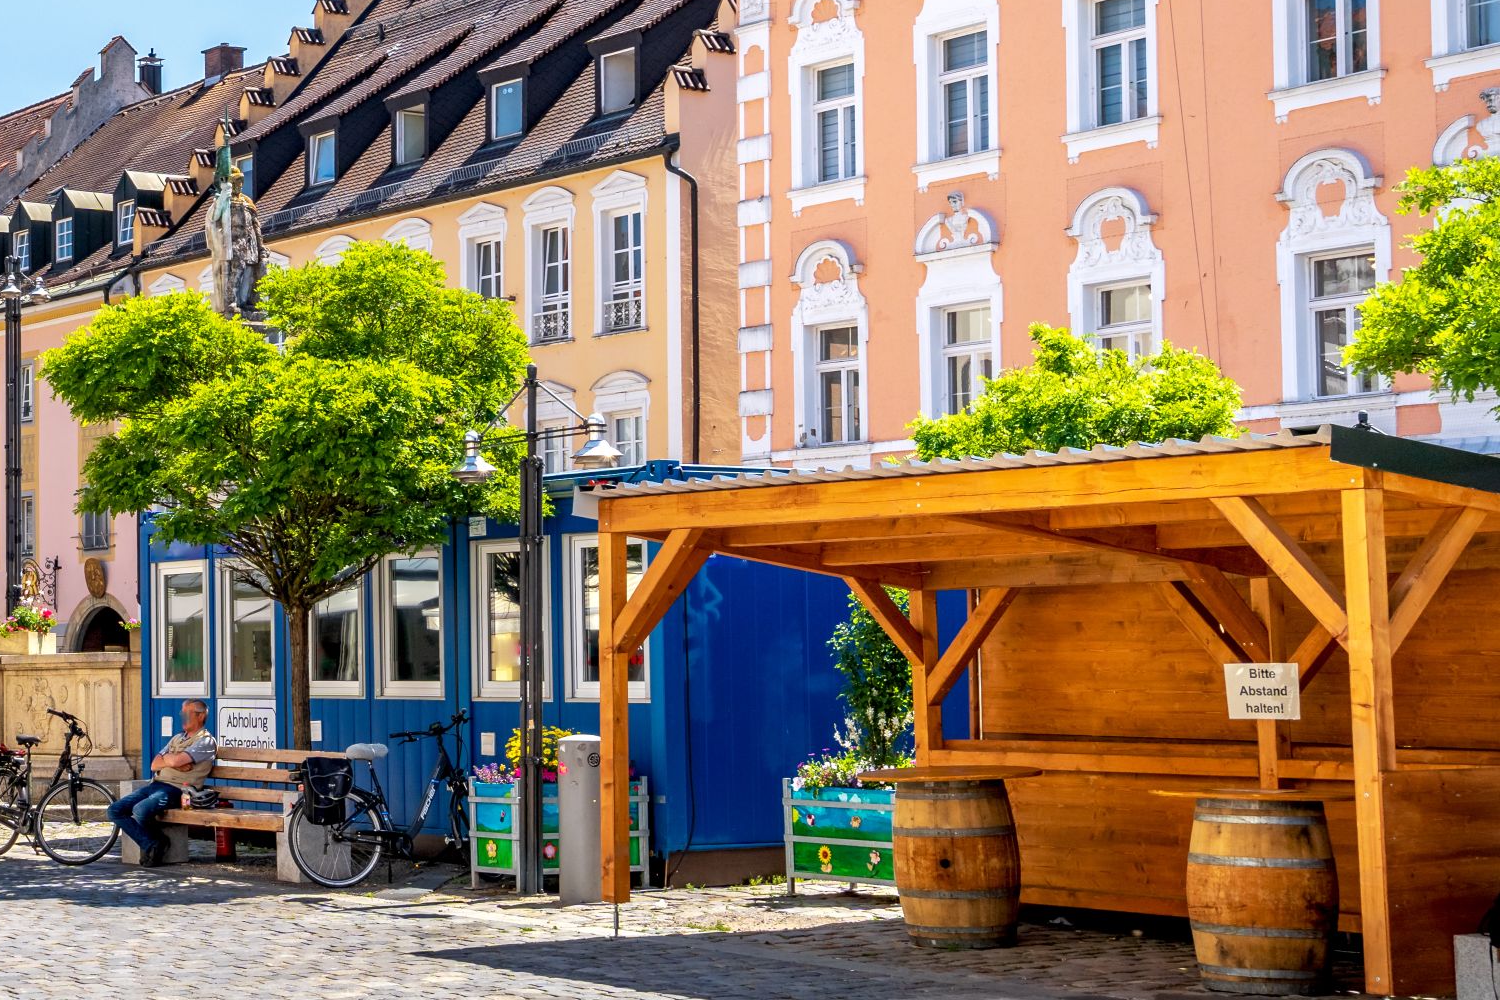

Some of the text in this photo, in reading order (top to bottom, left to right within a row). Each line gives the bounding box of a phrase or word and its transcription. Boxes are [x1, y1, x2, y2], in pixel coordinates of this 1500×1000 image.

[1249, 668, 1276, 679] Bitte
[1239, 685, 1288, 696] Abstand
[1245, 702, 1284, 713] halten!
[227, 712, 268, 732] Abholung
